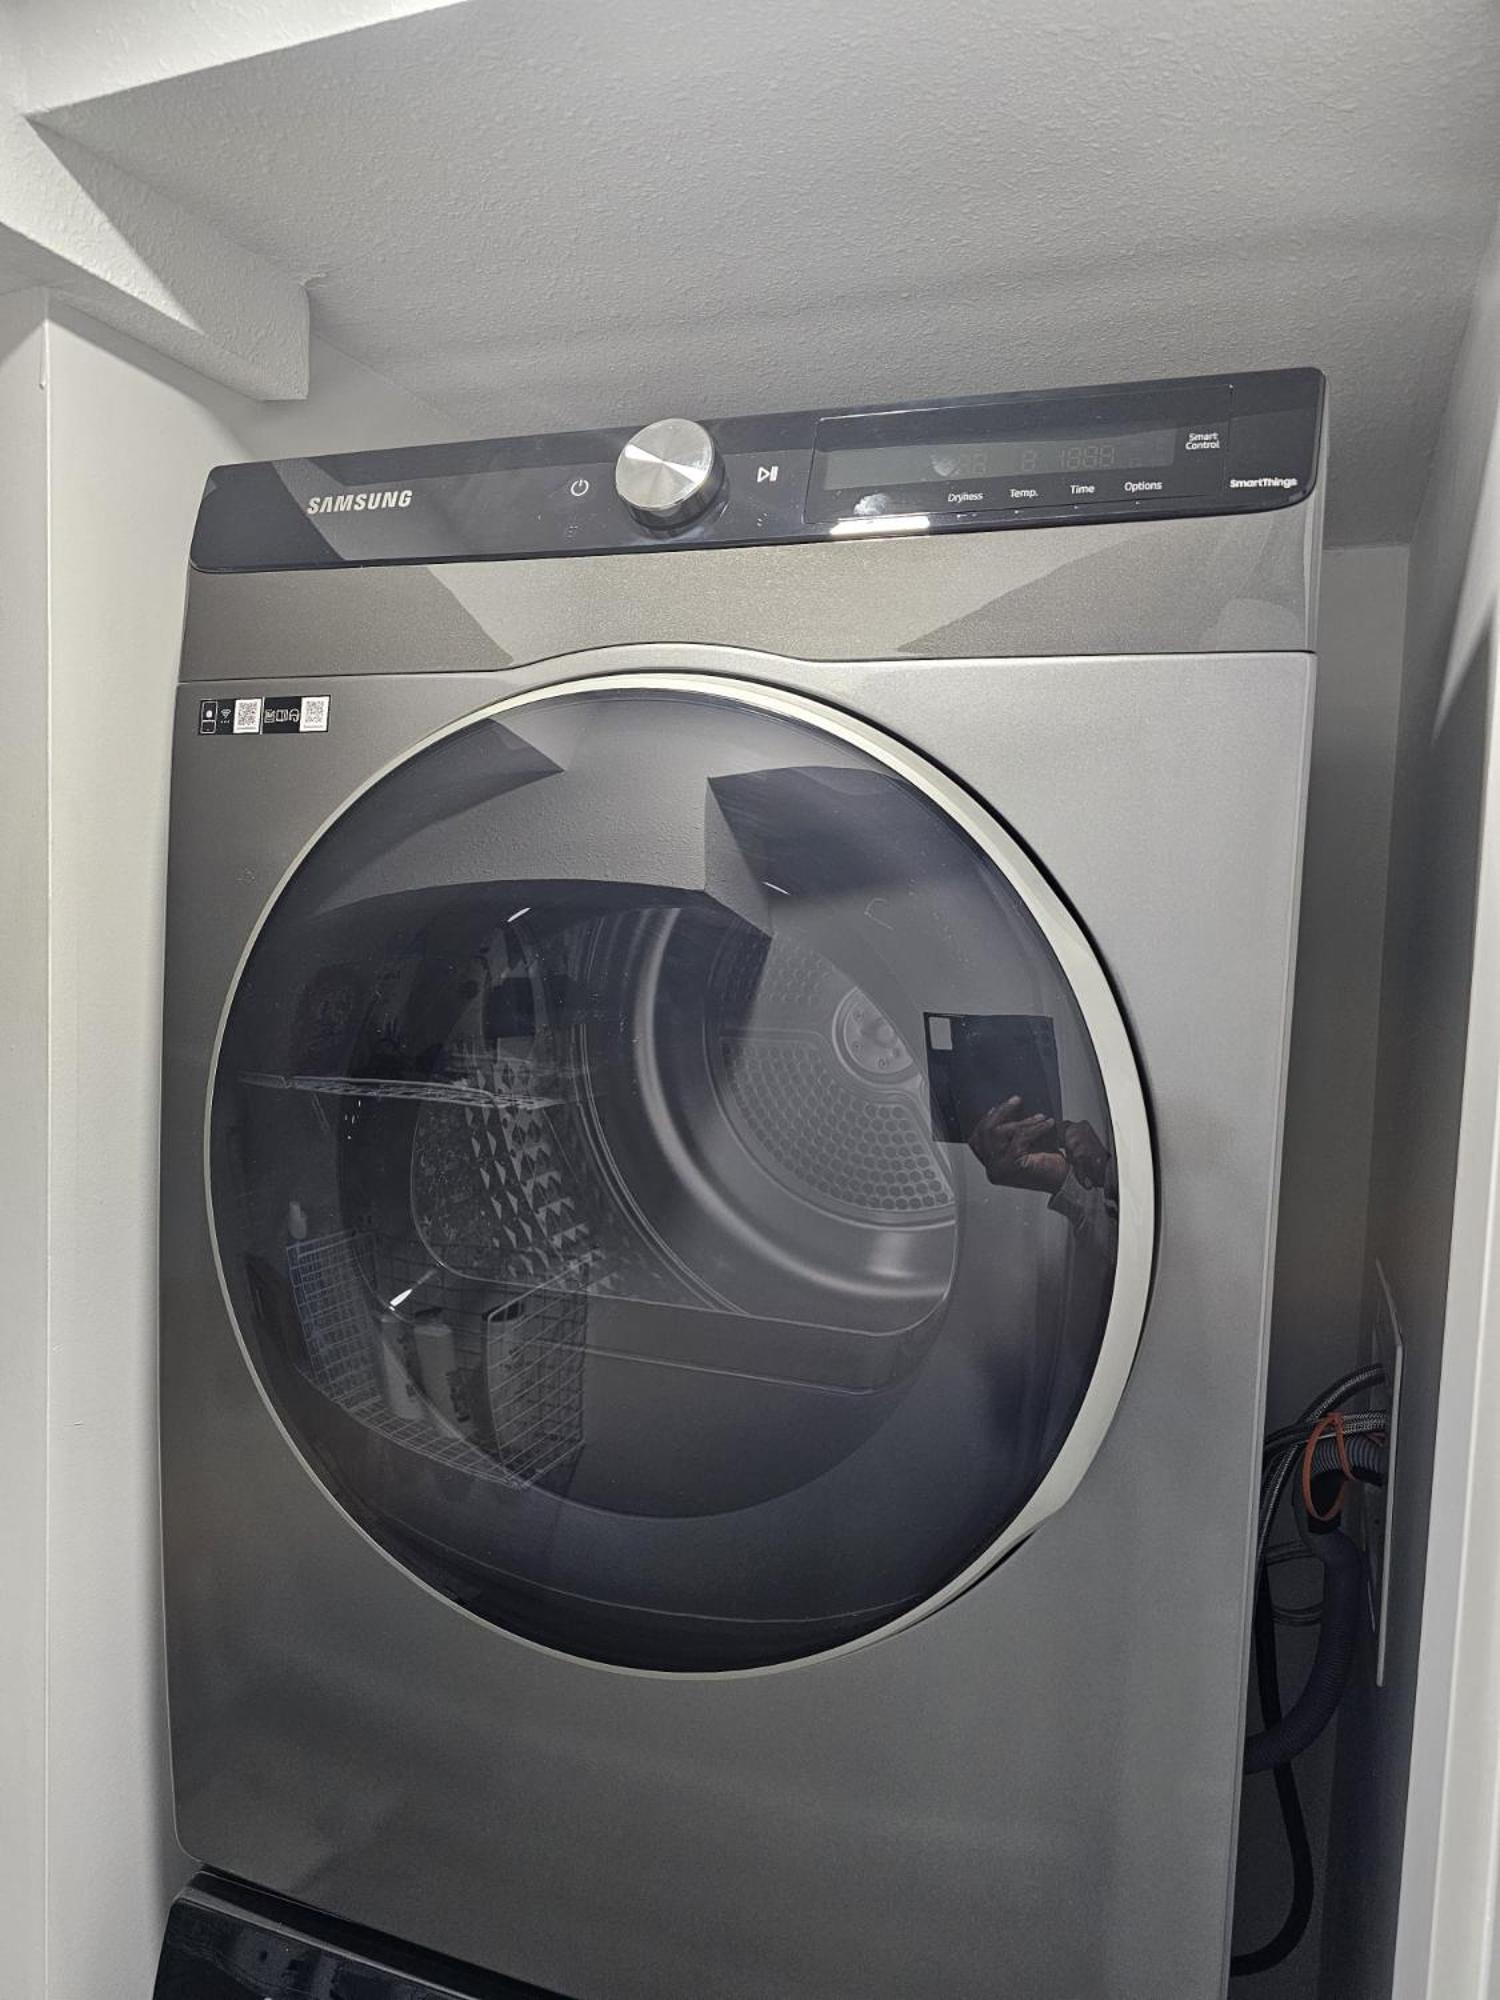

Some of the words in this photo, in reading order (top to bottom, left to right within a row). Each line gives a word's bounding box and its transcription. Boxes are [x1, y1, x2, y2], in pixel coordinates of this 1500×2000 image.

[1189, 432, 1218, 442] Smart
[1185, 440, 1220, 450] Control
[1124, 481, 1163, 493] Options
[1230, 477, 1298, 489] SmartThings
[1009, 488, 1039, 498] Temp.
[1070, 484, 1095, 494] Time
[307, 490, 413, 515] SAMSUNG
[948, 492, 983, 503] Dryness
